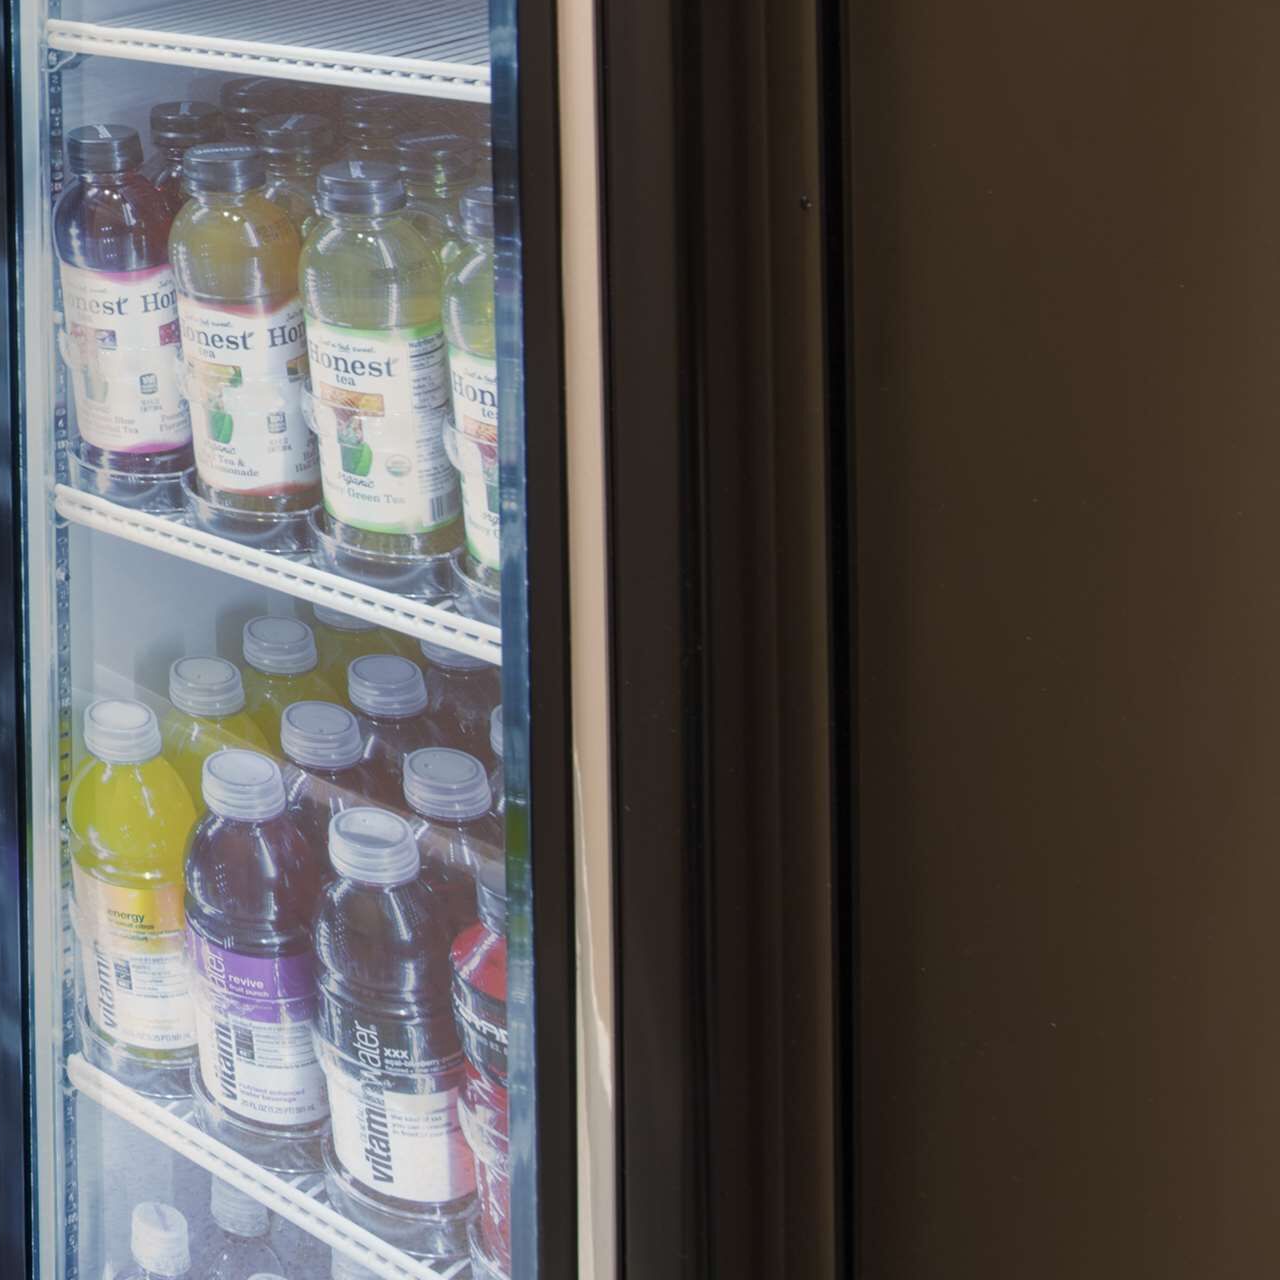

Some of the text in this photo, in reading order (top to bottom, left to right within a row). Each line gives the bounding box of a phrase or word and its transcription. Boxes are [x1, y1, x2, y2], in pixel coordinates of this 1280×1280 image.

[309, 343, 394, 378] Honest
[336, 374, 356, 386] tea
[107, 908, 145, 923] energy
[228, 974, 265, 989] revive
[353, 1020, 394, 1183] vitaminwater
